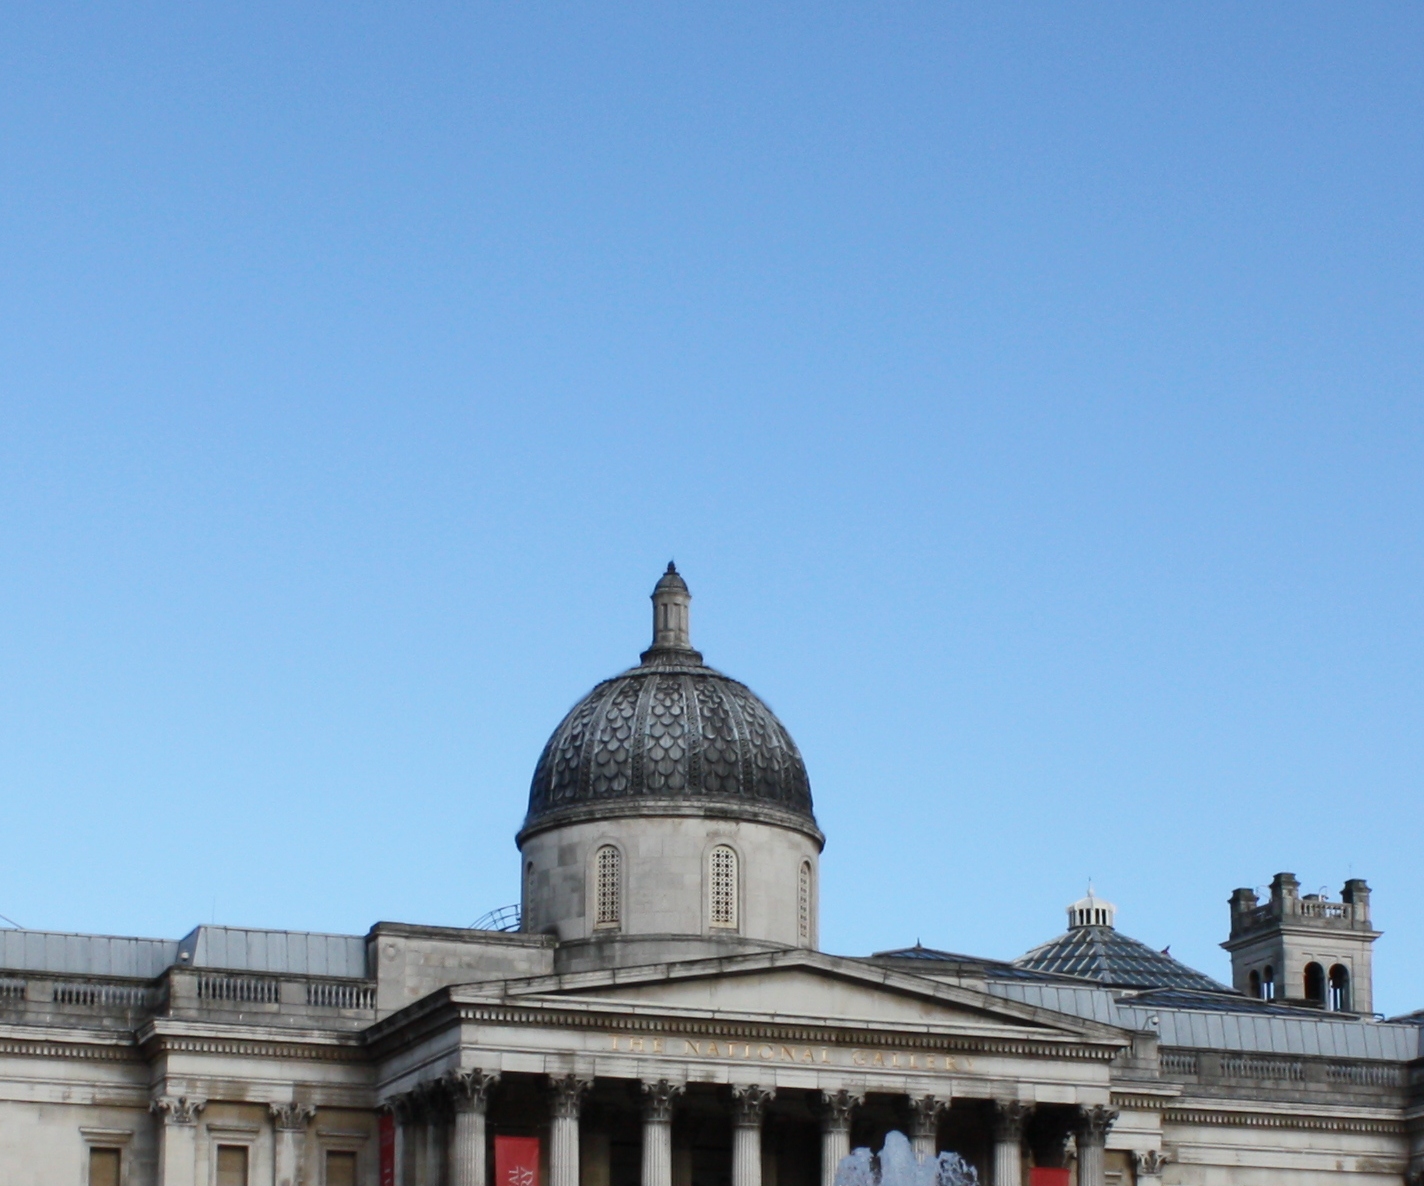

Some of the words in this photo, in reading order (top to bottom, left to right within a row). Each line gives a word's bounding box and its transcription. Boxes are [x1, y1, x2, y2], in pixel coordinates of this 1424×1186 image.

[608, 1034, 667, 1053] THE
[684, 1039, 831, 1065] NATIONAL
[852, 1050, 976, 1072] GALLERY
